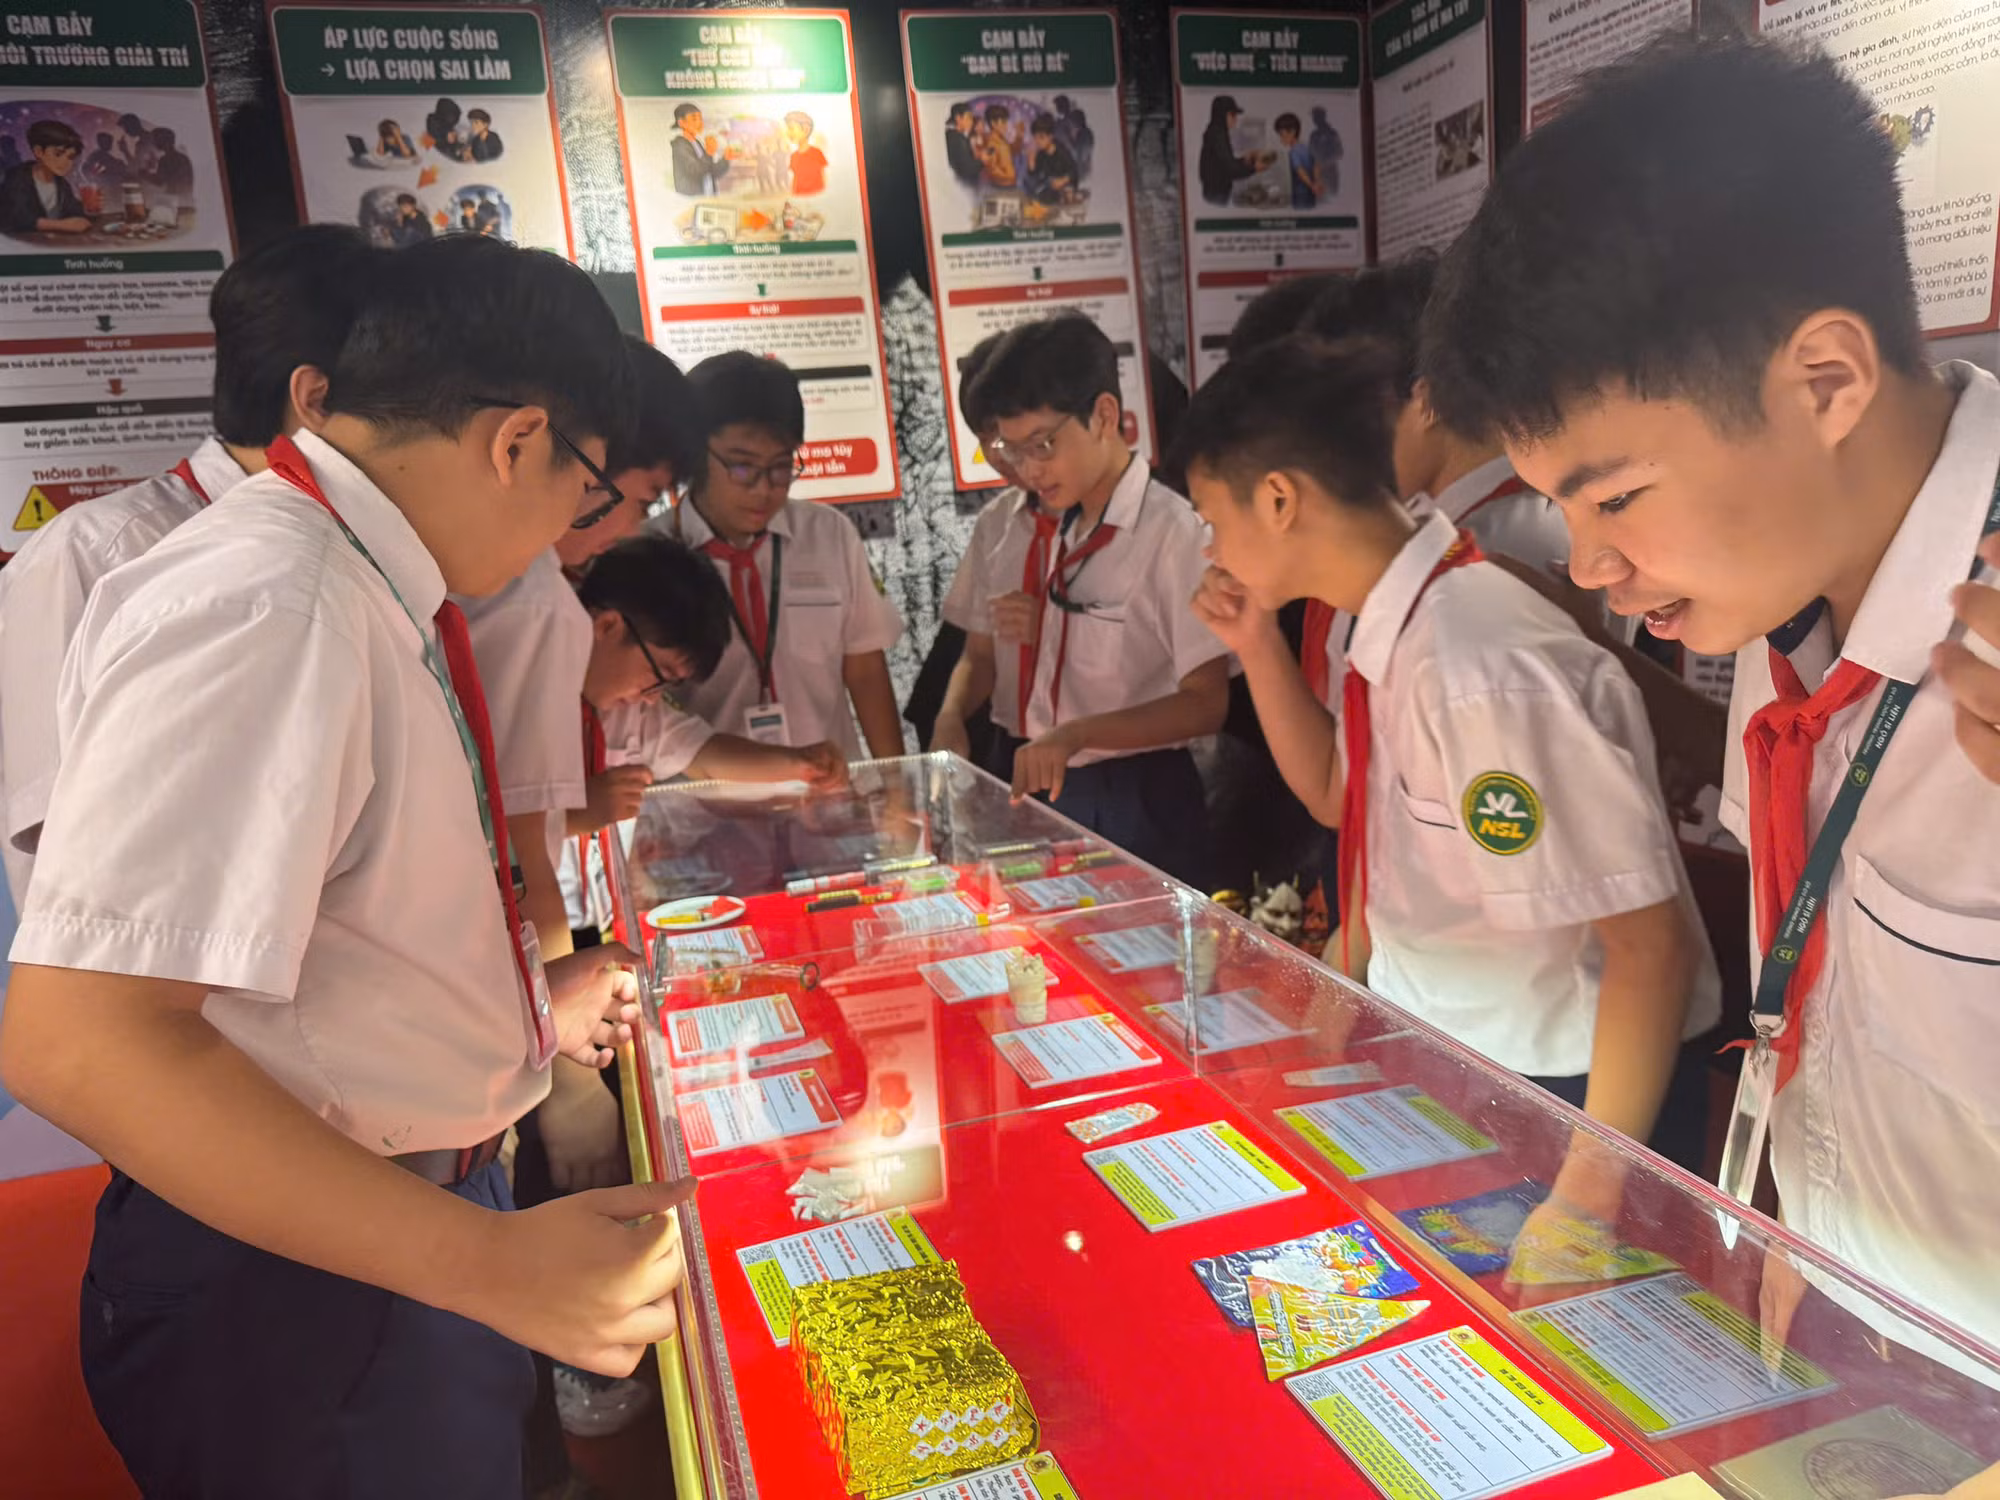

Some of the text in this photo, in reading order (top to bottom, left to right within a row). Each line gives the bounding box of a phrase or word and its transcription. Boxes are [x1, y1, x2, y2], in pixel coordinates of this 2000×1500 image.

[324, 23, 499, 53] ÁP LỰC CUỘC SỐNG
[982, 29, 1015, 52] CẠM
[345, 53, 512, 84] LỰA CHỌN SAI LẦM
[32, 466, 83, 482] THÔNG
[1479, 818, 1527, 839] NSL
